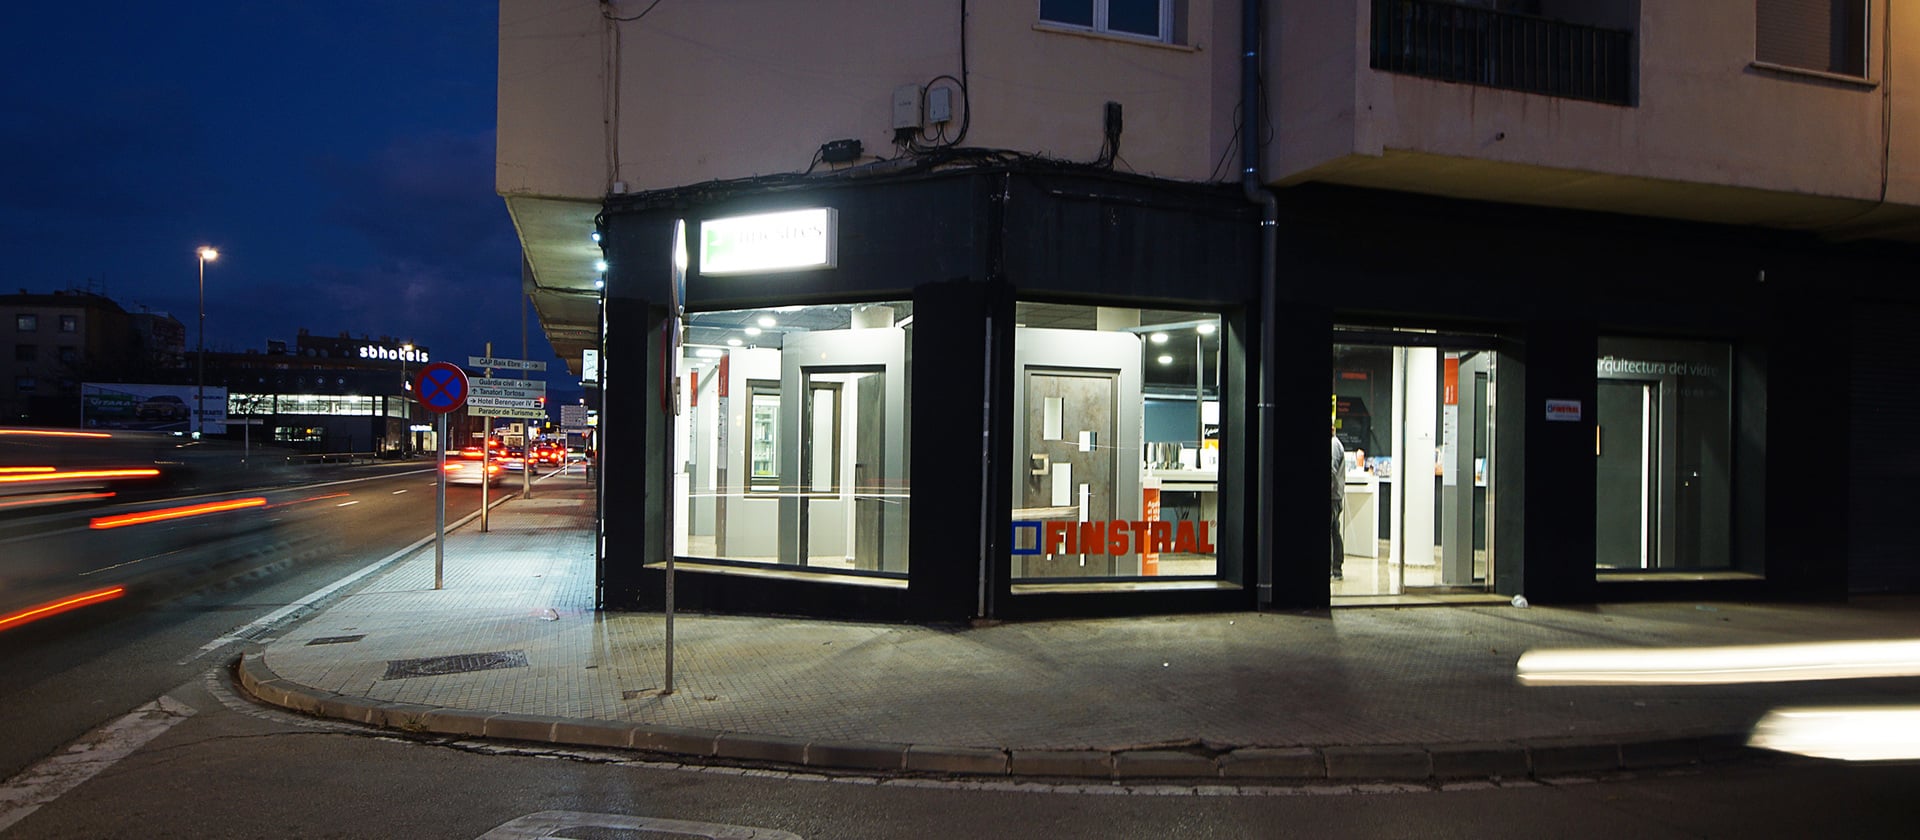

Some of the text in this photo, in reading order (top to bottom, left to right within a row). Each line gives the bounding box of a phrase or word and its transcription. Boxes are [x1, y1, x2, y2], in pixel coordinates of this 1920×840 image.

[359, 345, 429, 362] sbhotels
[1669, 361, 1687, 375] del
[480, 388, 525, 397] Tanatori Tortosa
[494, 399, 524, 408] Berenguer
[510, 409, 534, 417] Turisme
[1046, 519, 1215, 556] FINSTRAL
